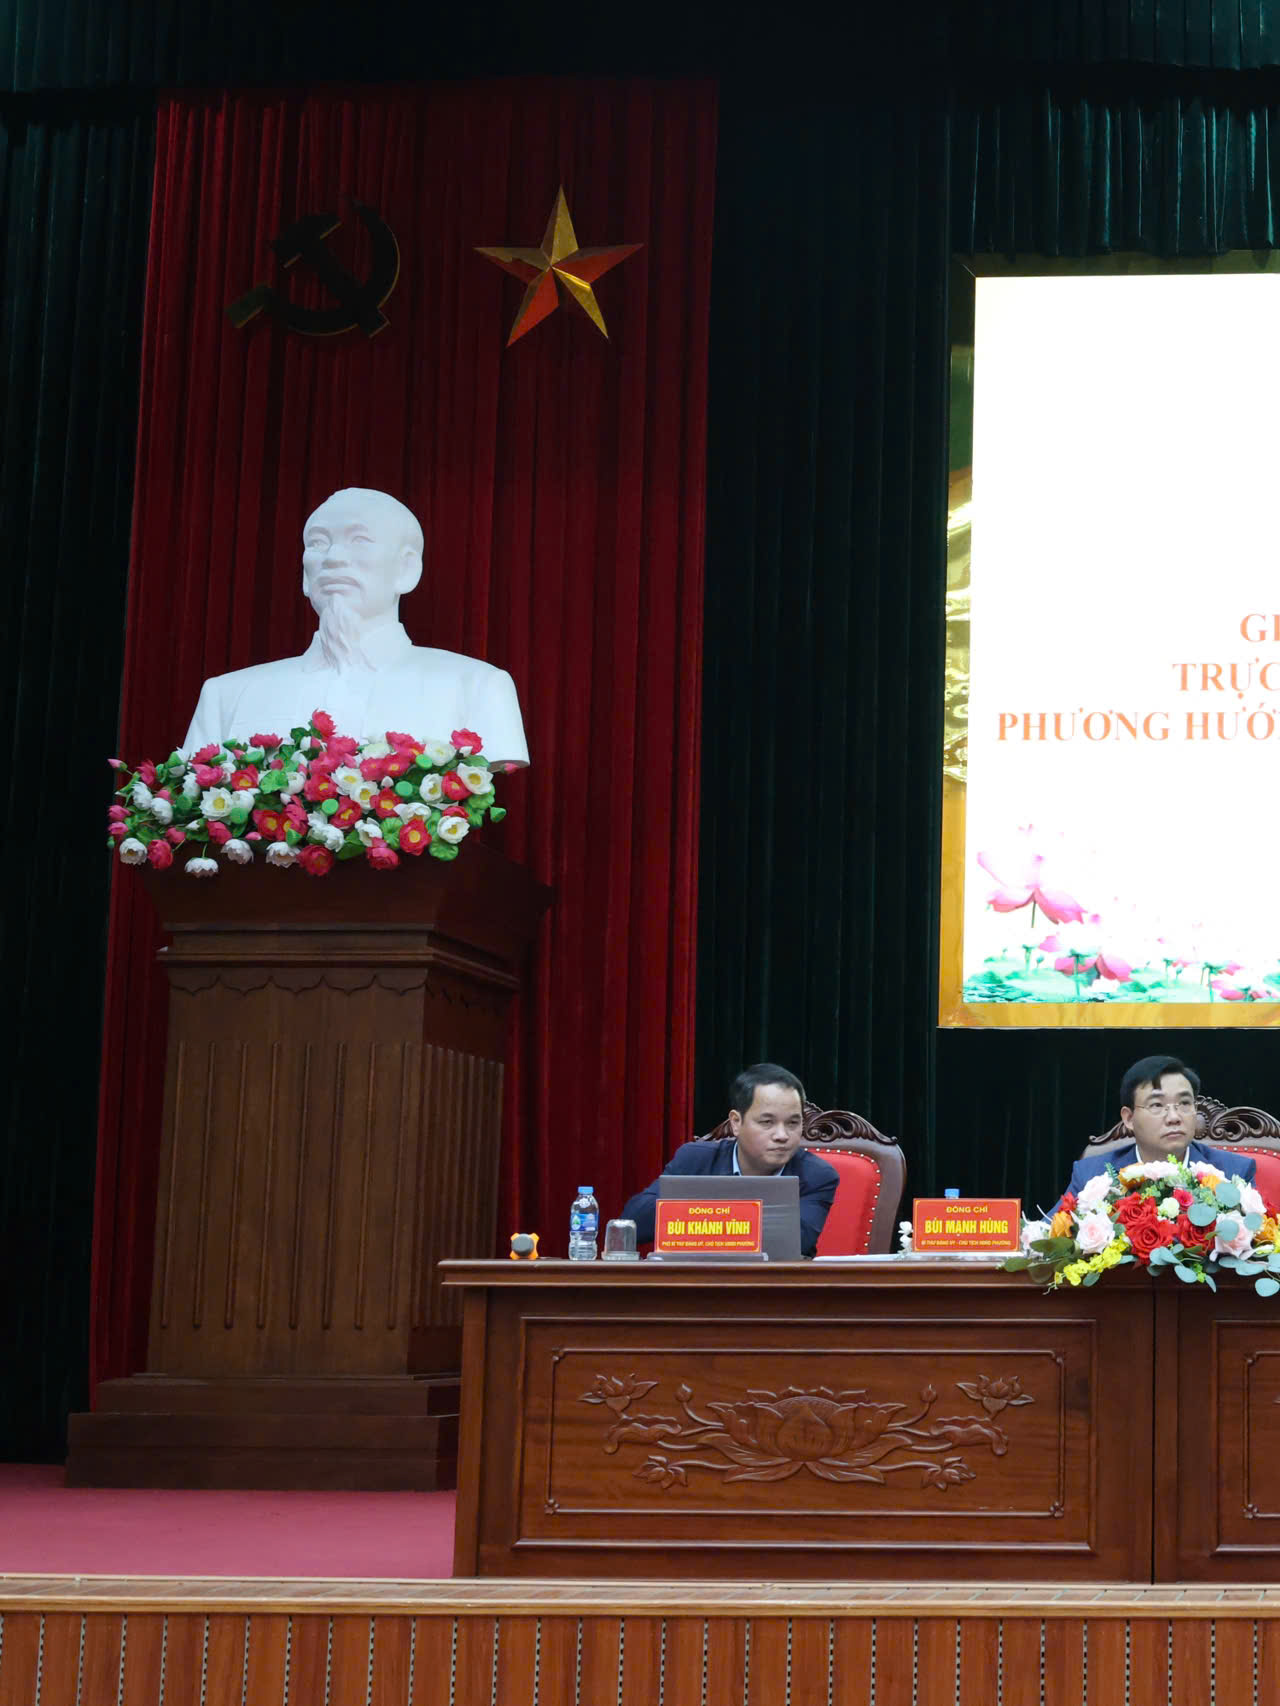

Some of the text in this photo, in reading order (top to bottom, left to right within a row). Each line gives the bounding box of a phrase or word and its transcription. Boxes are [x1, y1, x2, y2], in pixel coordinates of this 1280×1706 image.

[996, 707, 1170, 743] PHƯƠNG
[688, 1218, 723, 1235] KHÁNH
[726, 1218, 750, 1235] VĨNH
[945, 1220, 977, 1237] MẠNH
